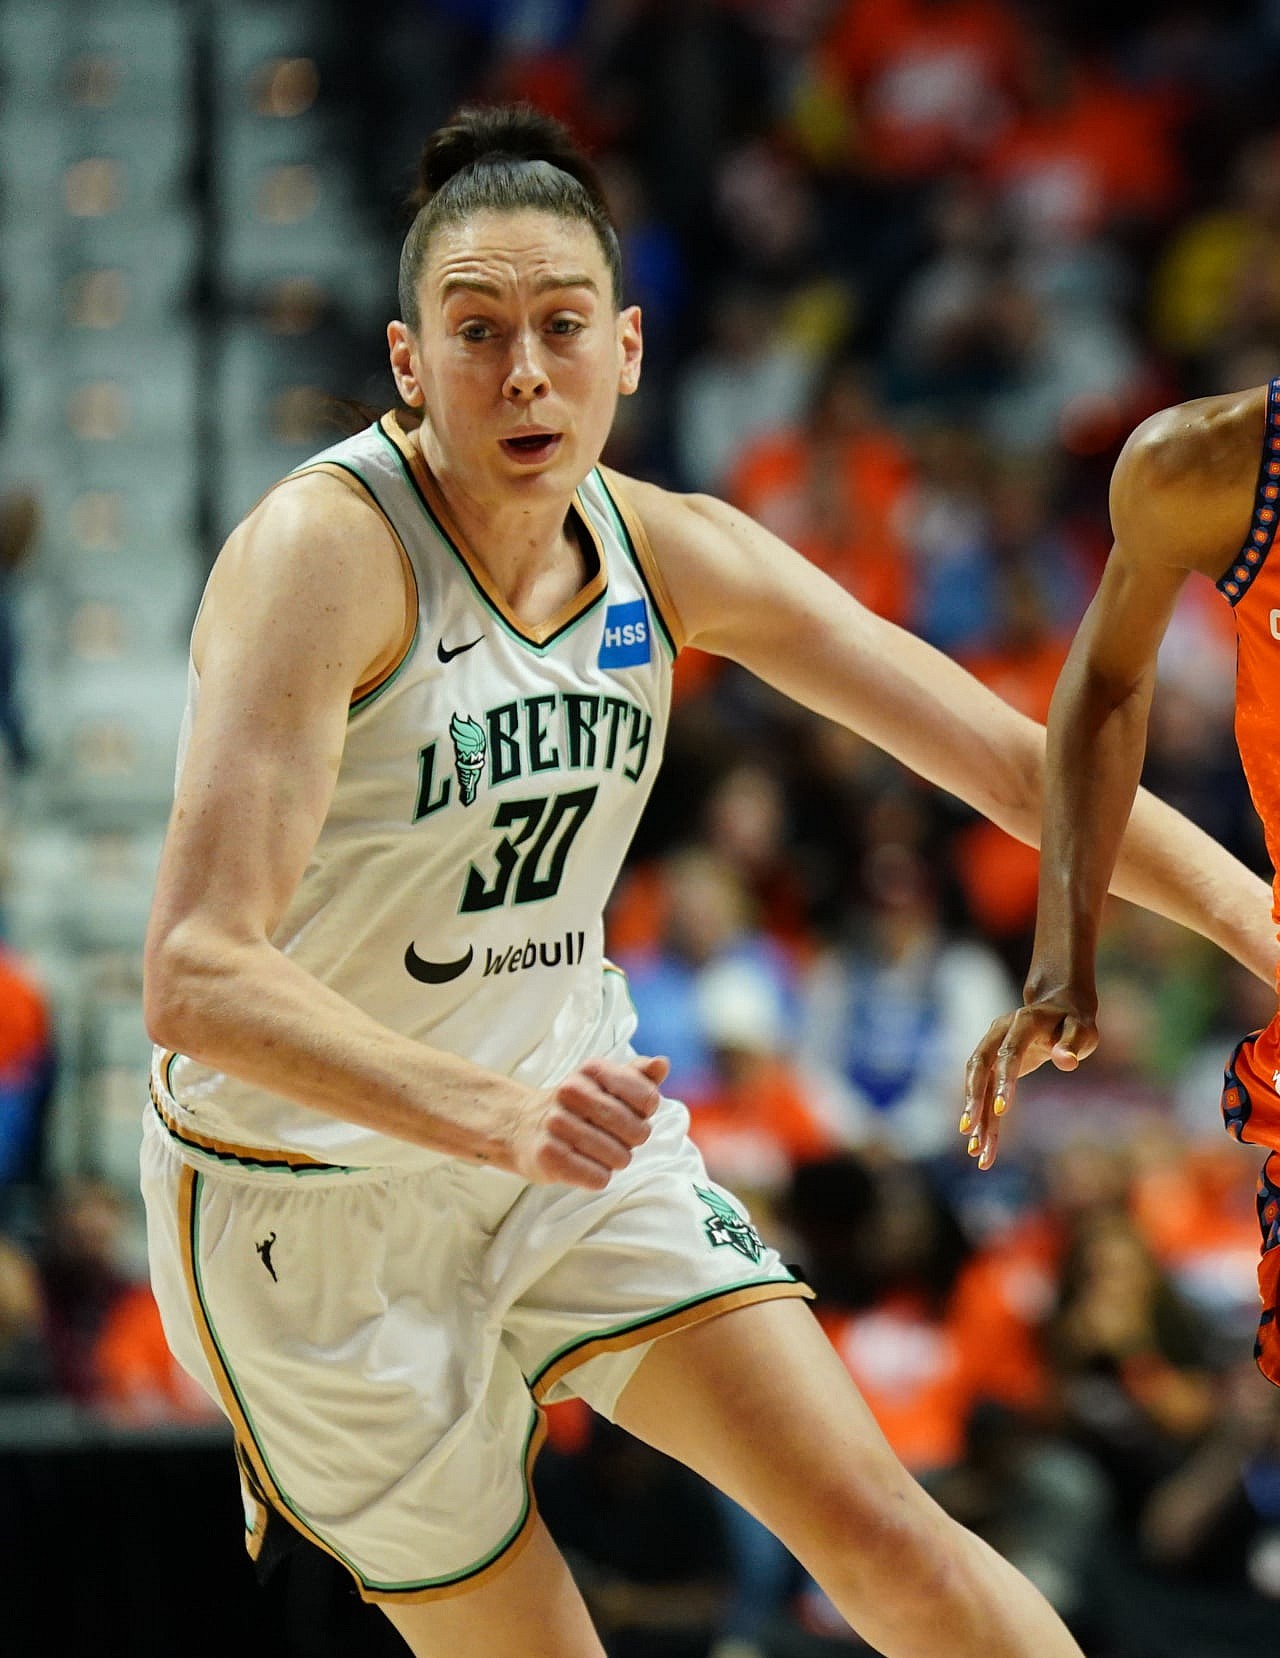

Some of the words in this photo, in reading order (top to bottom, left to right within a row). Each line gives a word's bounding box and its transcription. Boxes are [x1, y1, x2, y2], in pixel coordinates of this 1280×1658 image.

[605, 621, 647, 649] HSS
[457, 783, 600, 915] 30
[482, 931, 585, 978] Webull
